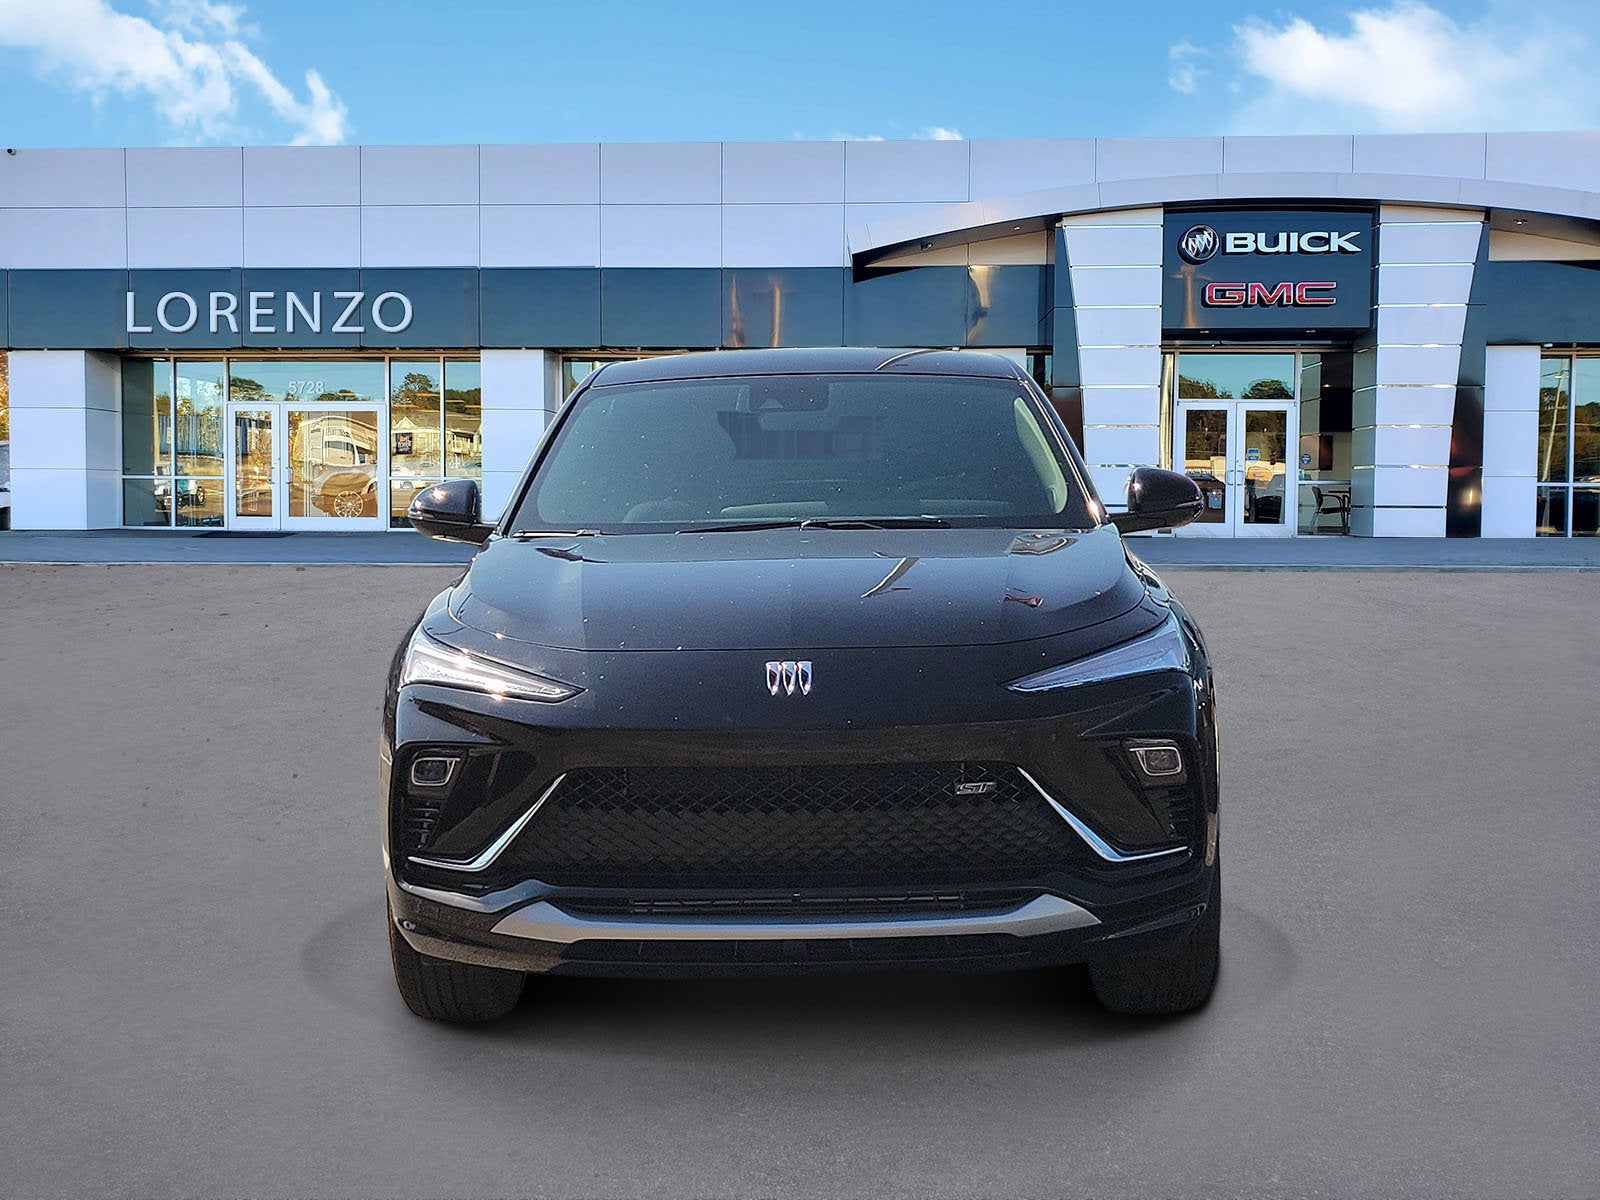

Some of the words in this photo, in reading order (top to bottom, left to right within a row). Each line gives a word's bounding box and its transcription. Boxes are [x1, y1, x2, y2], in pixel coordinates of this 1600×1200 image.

[1224, 231, 1362, 253] BUICK
[1205, 281, 1337, 305] GMC
[125, 291, 414, 333] LORENZO
[287, 380, 325, 394] 5728
